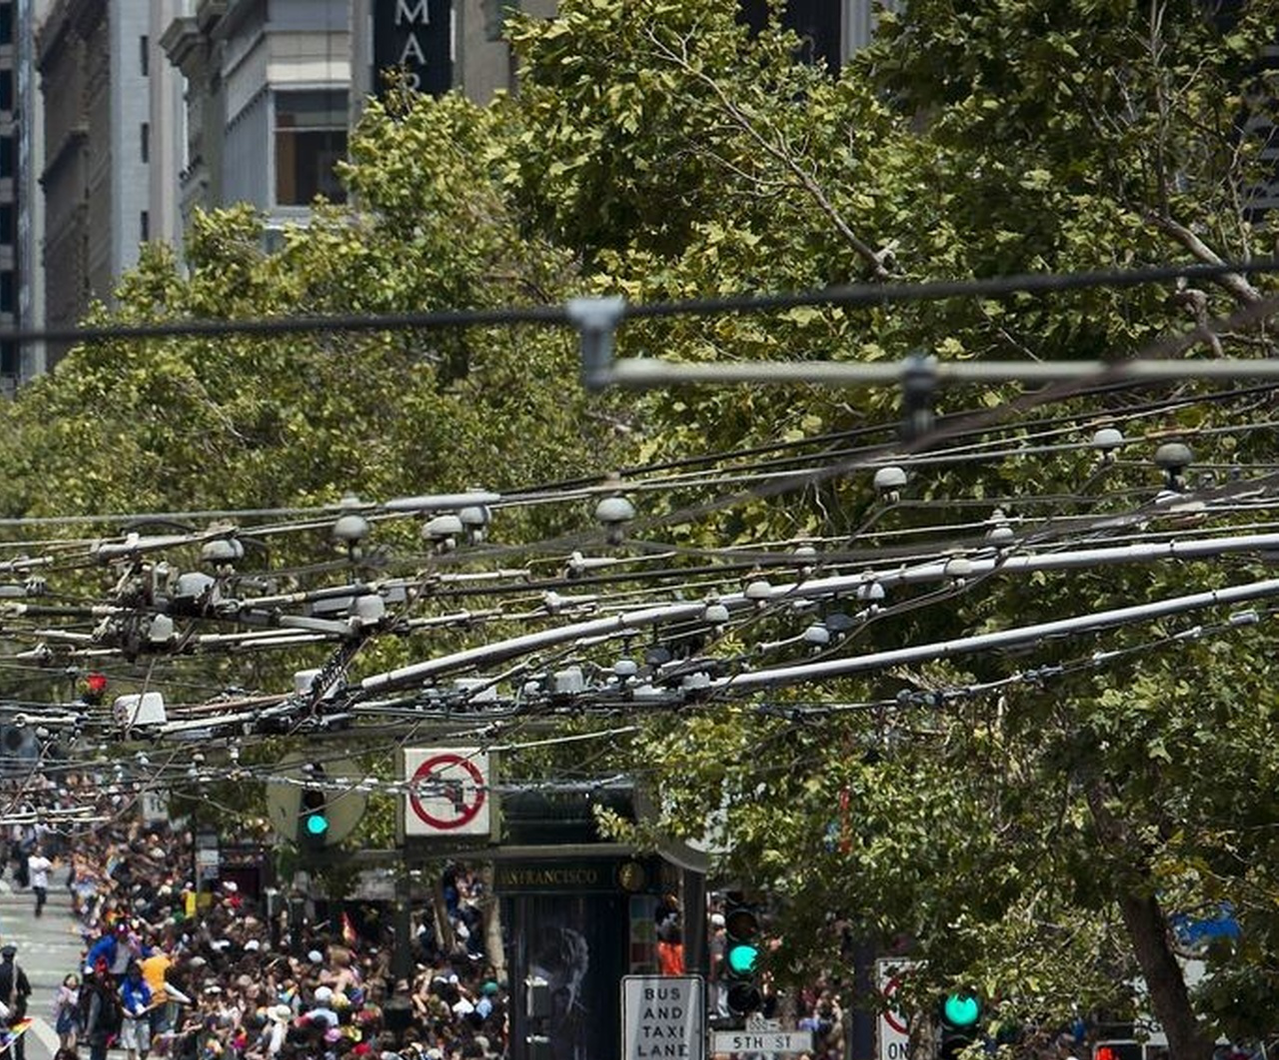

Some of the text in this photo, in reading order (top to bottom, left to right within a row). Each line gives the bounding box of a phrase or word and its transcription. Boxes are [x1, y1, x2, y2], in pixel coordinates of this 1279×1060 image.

[644, 988, 681, 1000] BUS
[643, 1008, 683, 1020] AND
[643, 1026, 685, 1038] TAXI
[733, 1035, 790, 1049] 5TH ST
[638, 1045, 689, 1057] LANE
